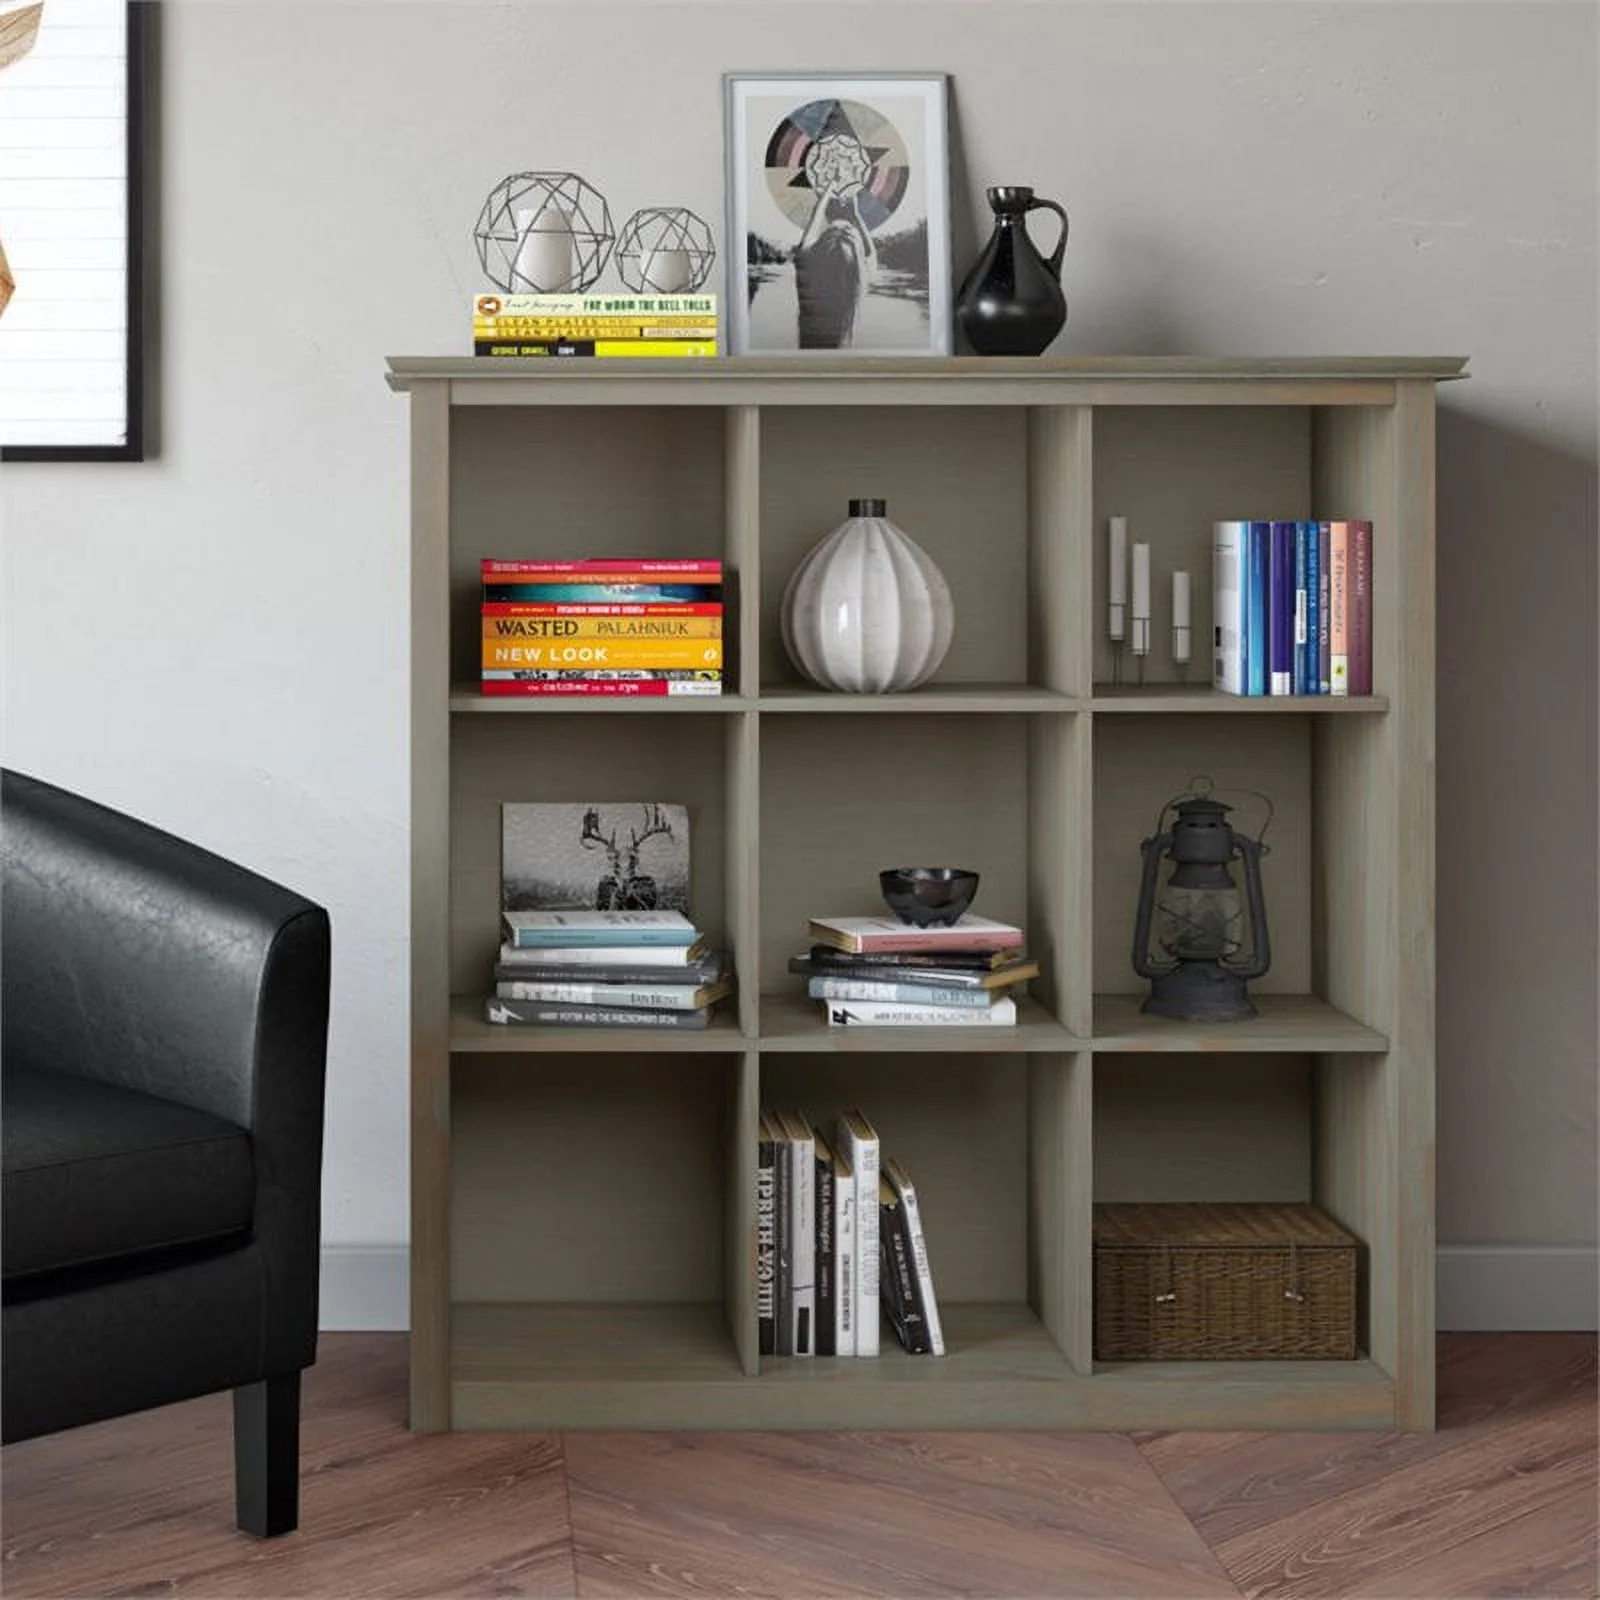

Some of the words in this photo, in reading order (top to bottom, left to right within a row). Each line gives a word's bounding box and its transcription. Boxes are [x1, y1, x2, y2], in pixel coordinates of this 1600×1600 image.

[494, 620, 579, 637] WASTED
[596, 620, 690, 636] PALAHNIUK
[494, 647, 542, 662] NEW
[549, 647, 609, 662] LOOK
